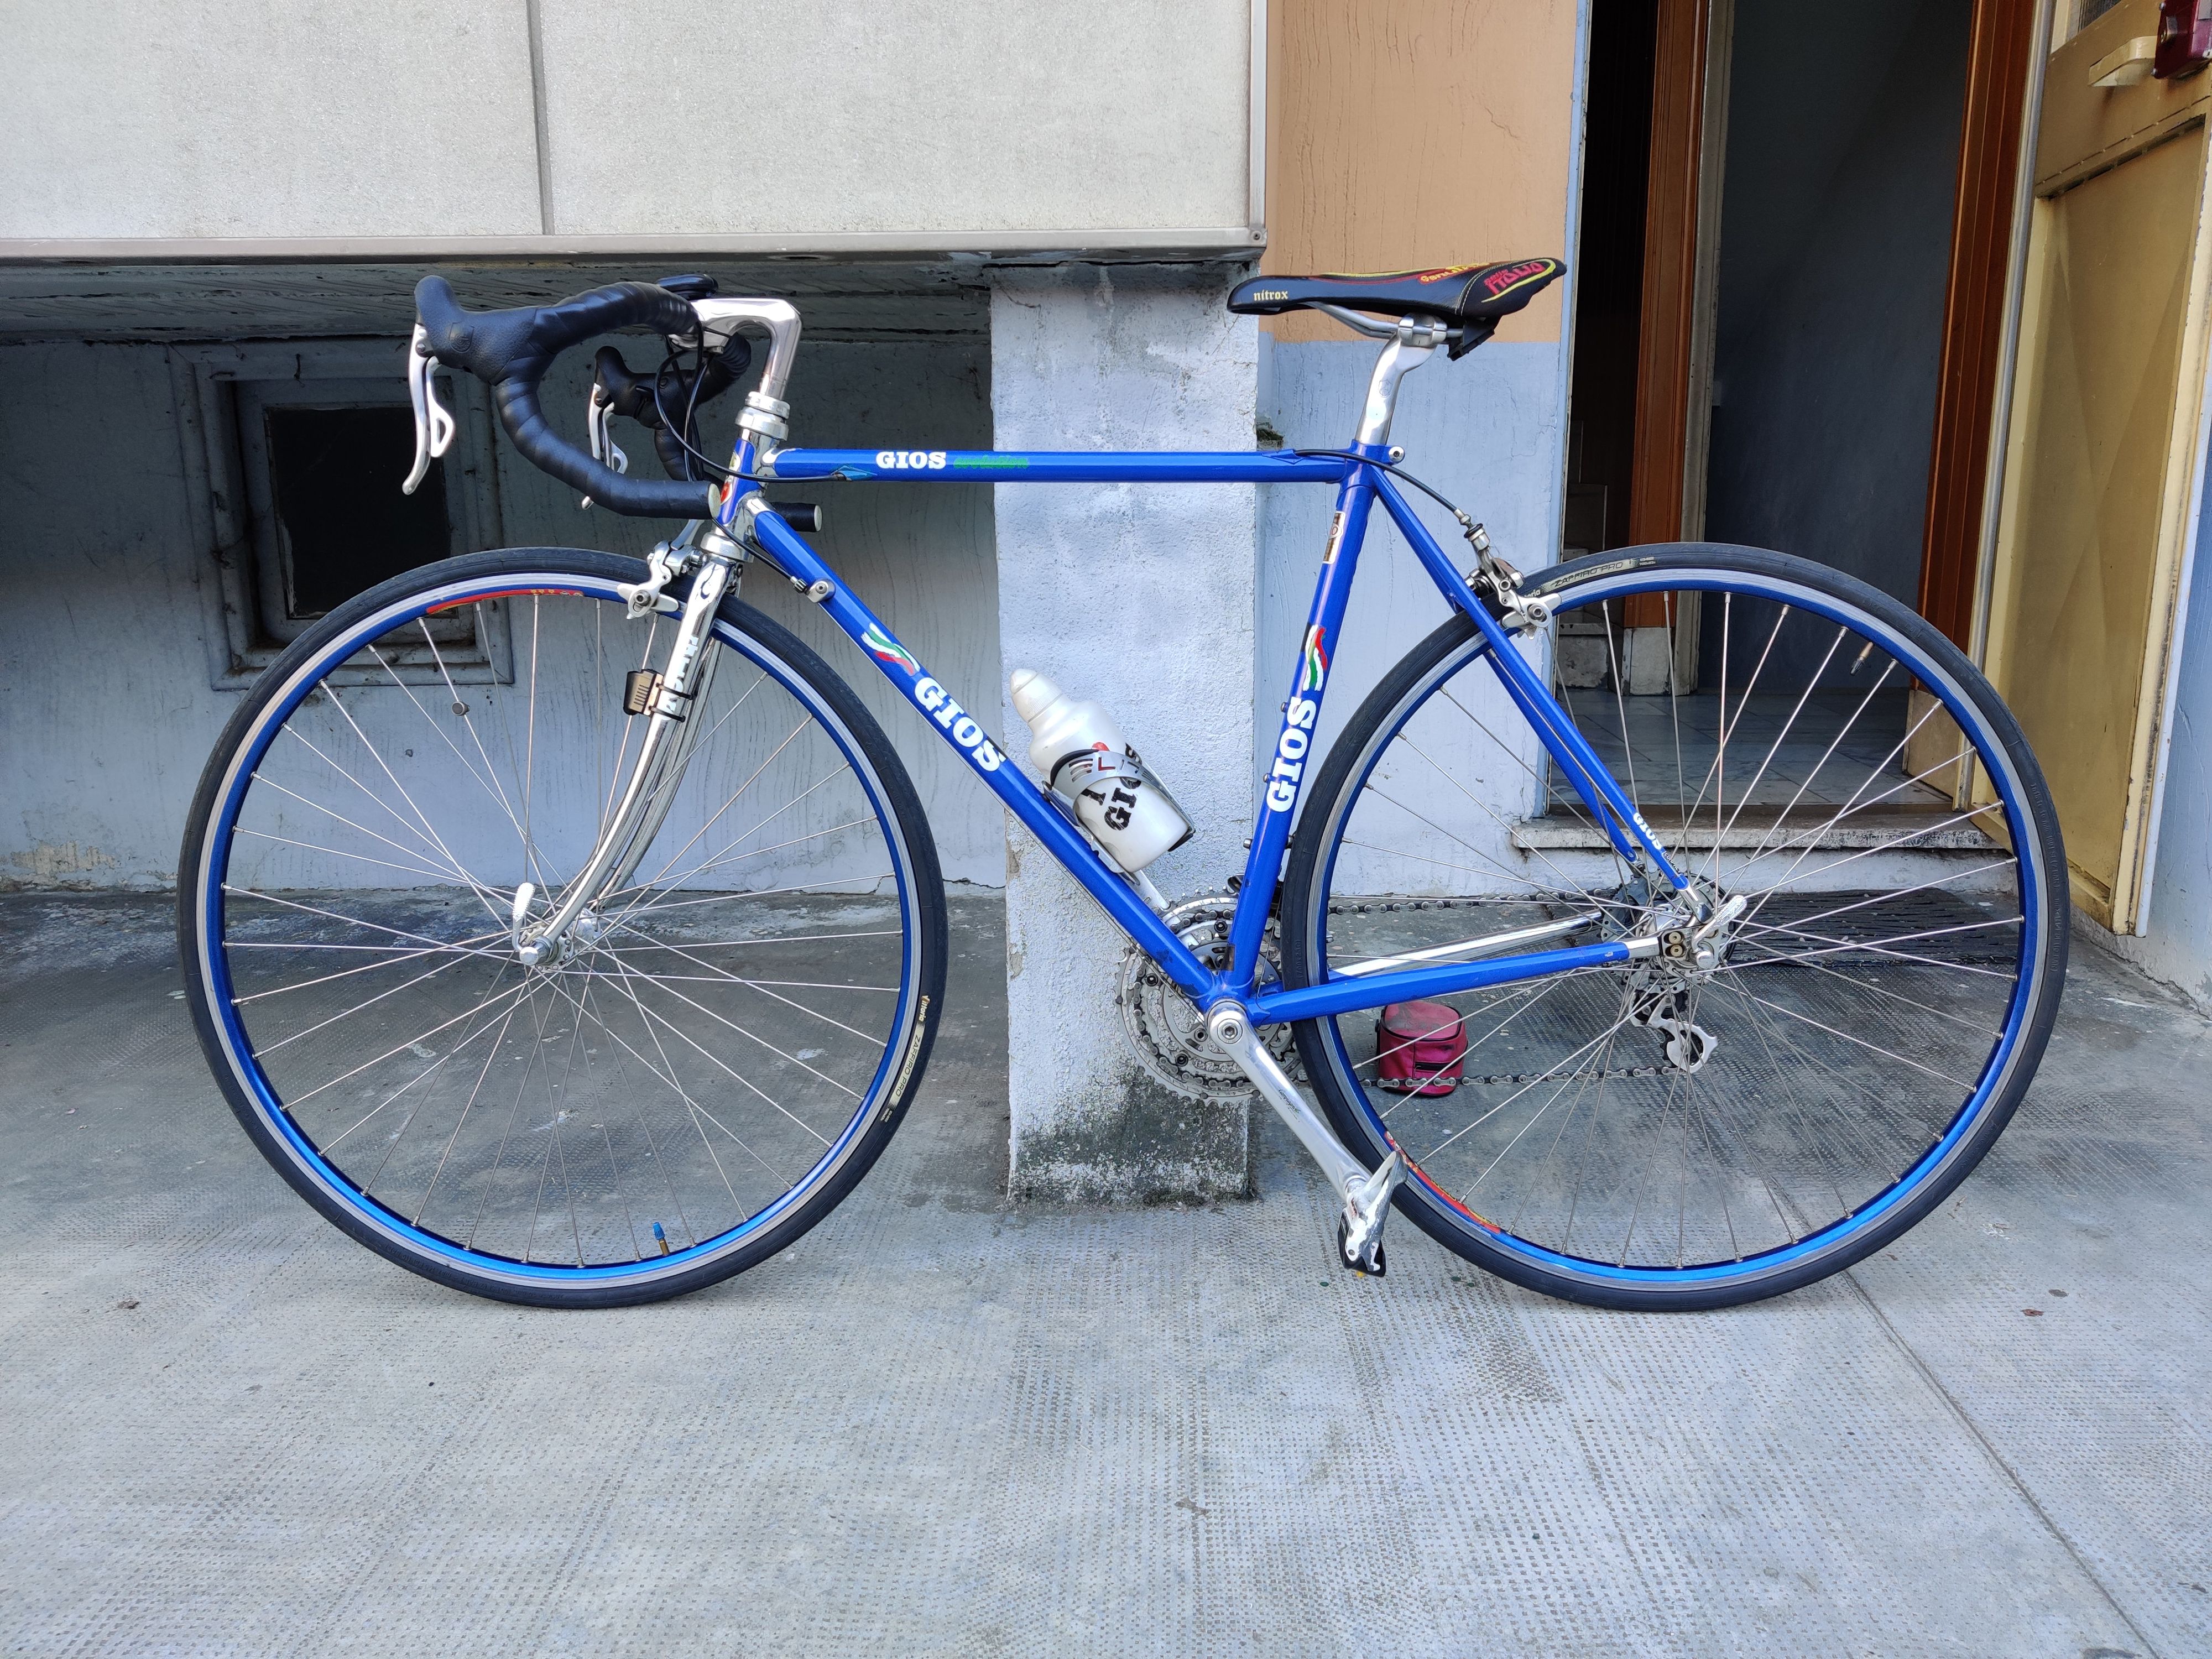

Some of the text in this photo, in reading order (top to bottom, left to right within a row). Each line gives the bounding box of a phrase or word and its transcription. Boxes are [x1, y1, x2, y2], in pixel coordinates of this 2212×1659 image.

[1253, 289, 1288, 301] nitrox
[875, 451, 947, 469] GIOS
[1554, 561, 1624, 587] ZAFFIRO PRO
[914, 677, 1006, 771] GIOS
[1266, 696, 1317, 813] GIOS
[1633, 812, 1662, 851] GIOS
[919, 995, 930, 1022] Vittoria
[895, 1034, 921, 1097] ZAFFIRO PRO
